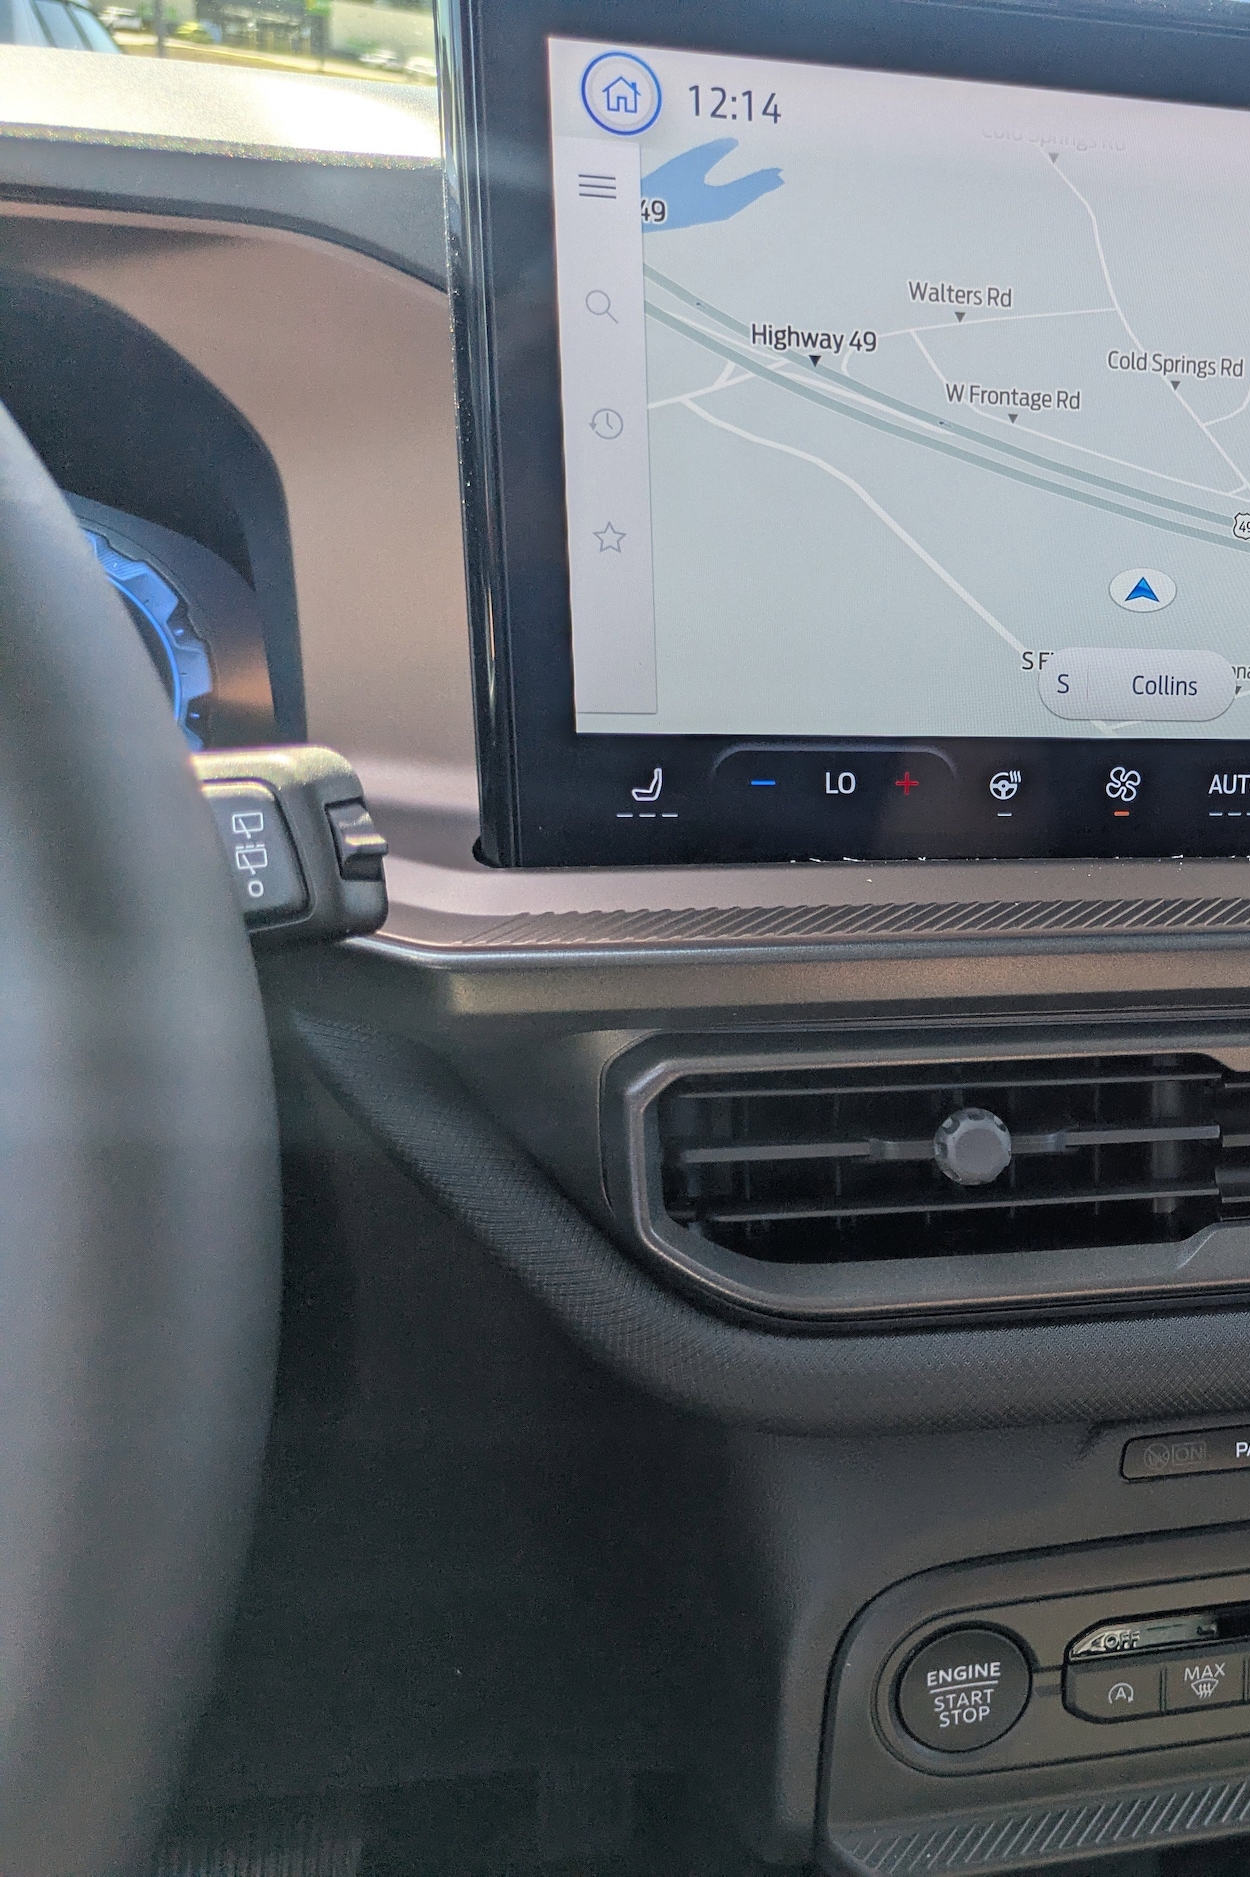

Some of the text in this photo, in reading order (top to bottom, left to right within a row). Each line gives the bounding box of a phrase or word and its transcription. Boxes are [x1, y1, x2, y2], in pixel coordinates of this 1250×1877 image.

[687, 85, 782, 124] 12:14
[908, 281, 1013, 308] Walters Rd
[751, 323, 877, 354] Highway 49
[1107, 350, 1244, 379] Cold Springs Rd
[945, 383, 1080, 411] W Frontage Rd
[1021, 652, 1034, 670] S
[1057, 673, 1070, 694] S
[1131, 674, 1198, 696] Collins
[824, 771, 856, 795] LO
[926, 1661, 1001, 1687] ENGINE
[1184, 1662, 1226, 1681] MAX
[933, 1688, 995, 1713] START
[938, 1705, 991, 1728] STOP
